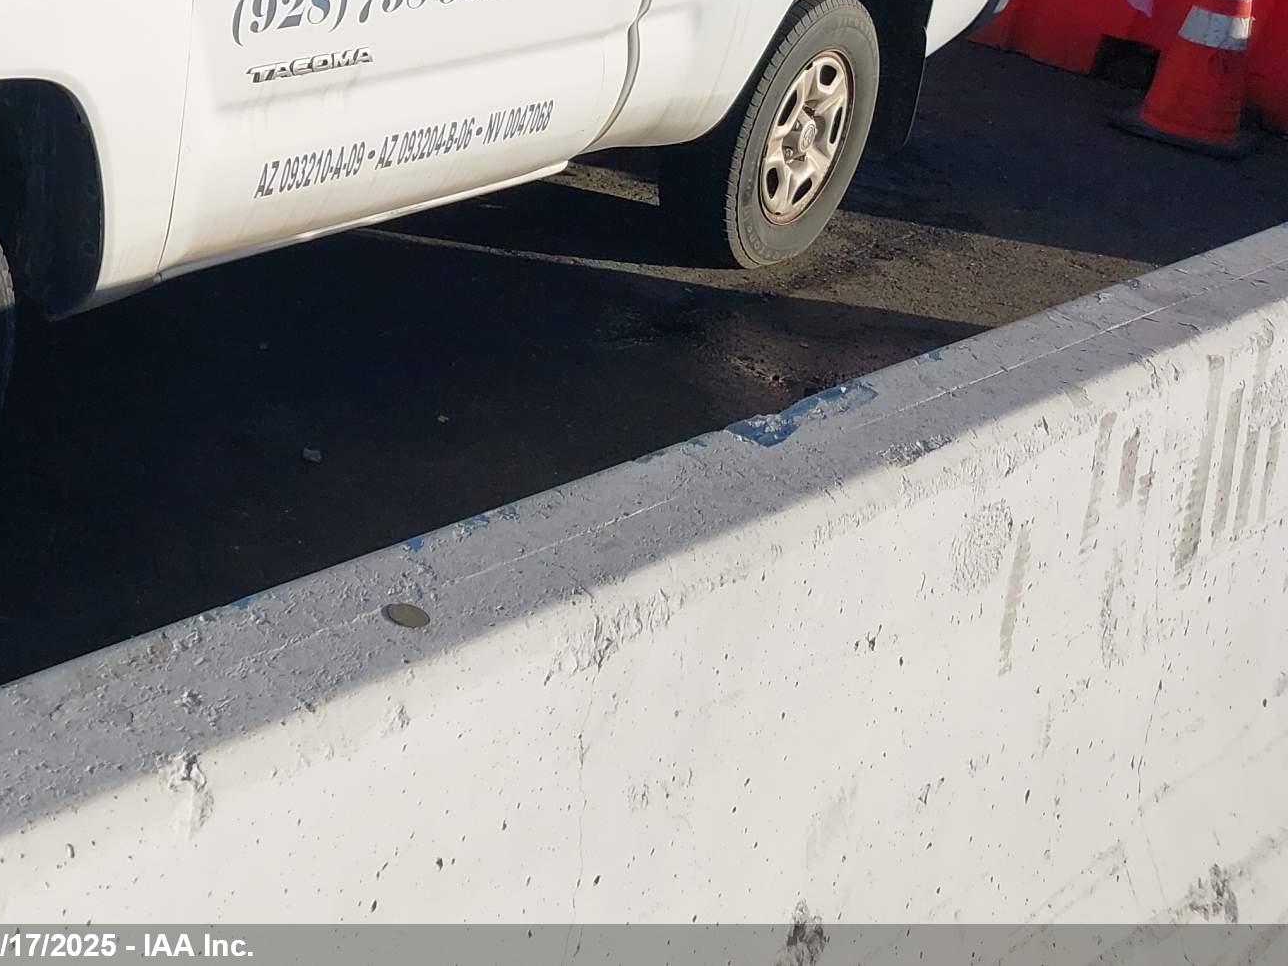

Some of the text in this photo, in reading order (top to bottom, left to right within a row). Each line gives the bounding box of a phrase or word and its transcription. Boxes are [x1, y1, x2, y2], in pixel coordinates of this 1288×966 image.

[246, 47, 373, 83] TACOMA
[254, 99, 554, 198] AZ 093210-A-09 AZ 093204-B-06 NV 0047068
